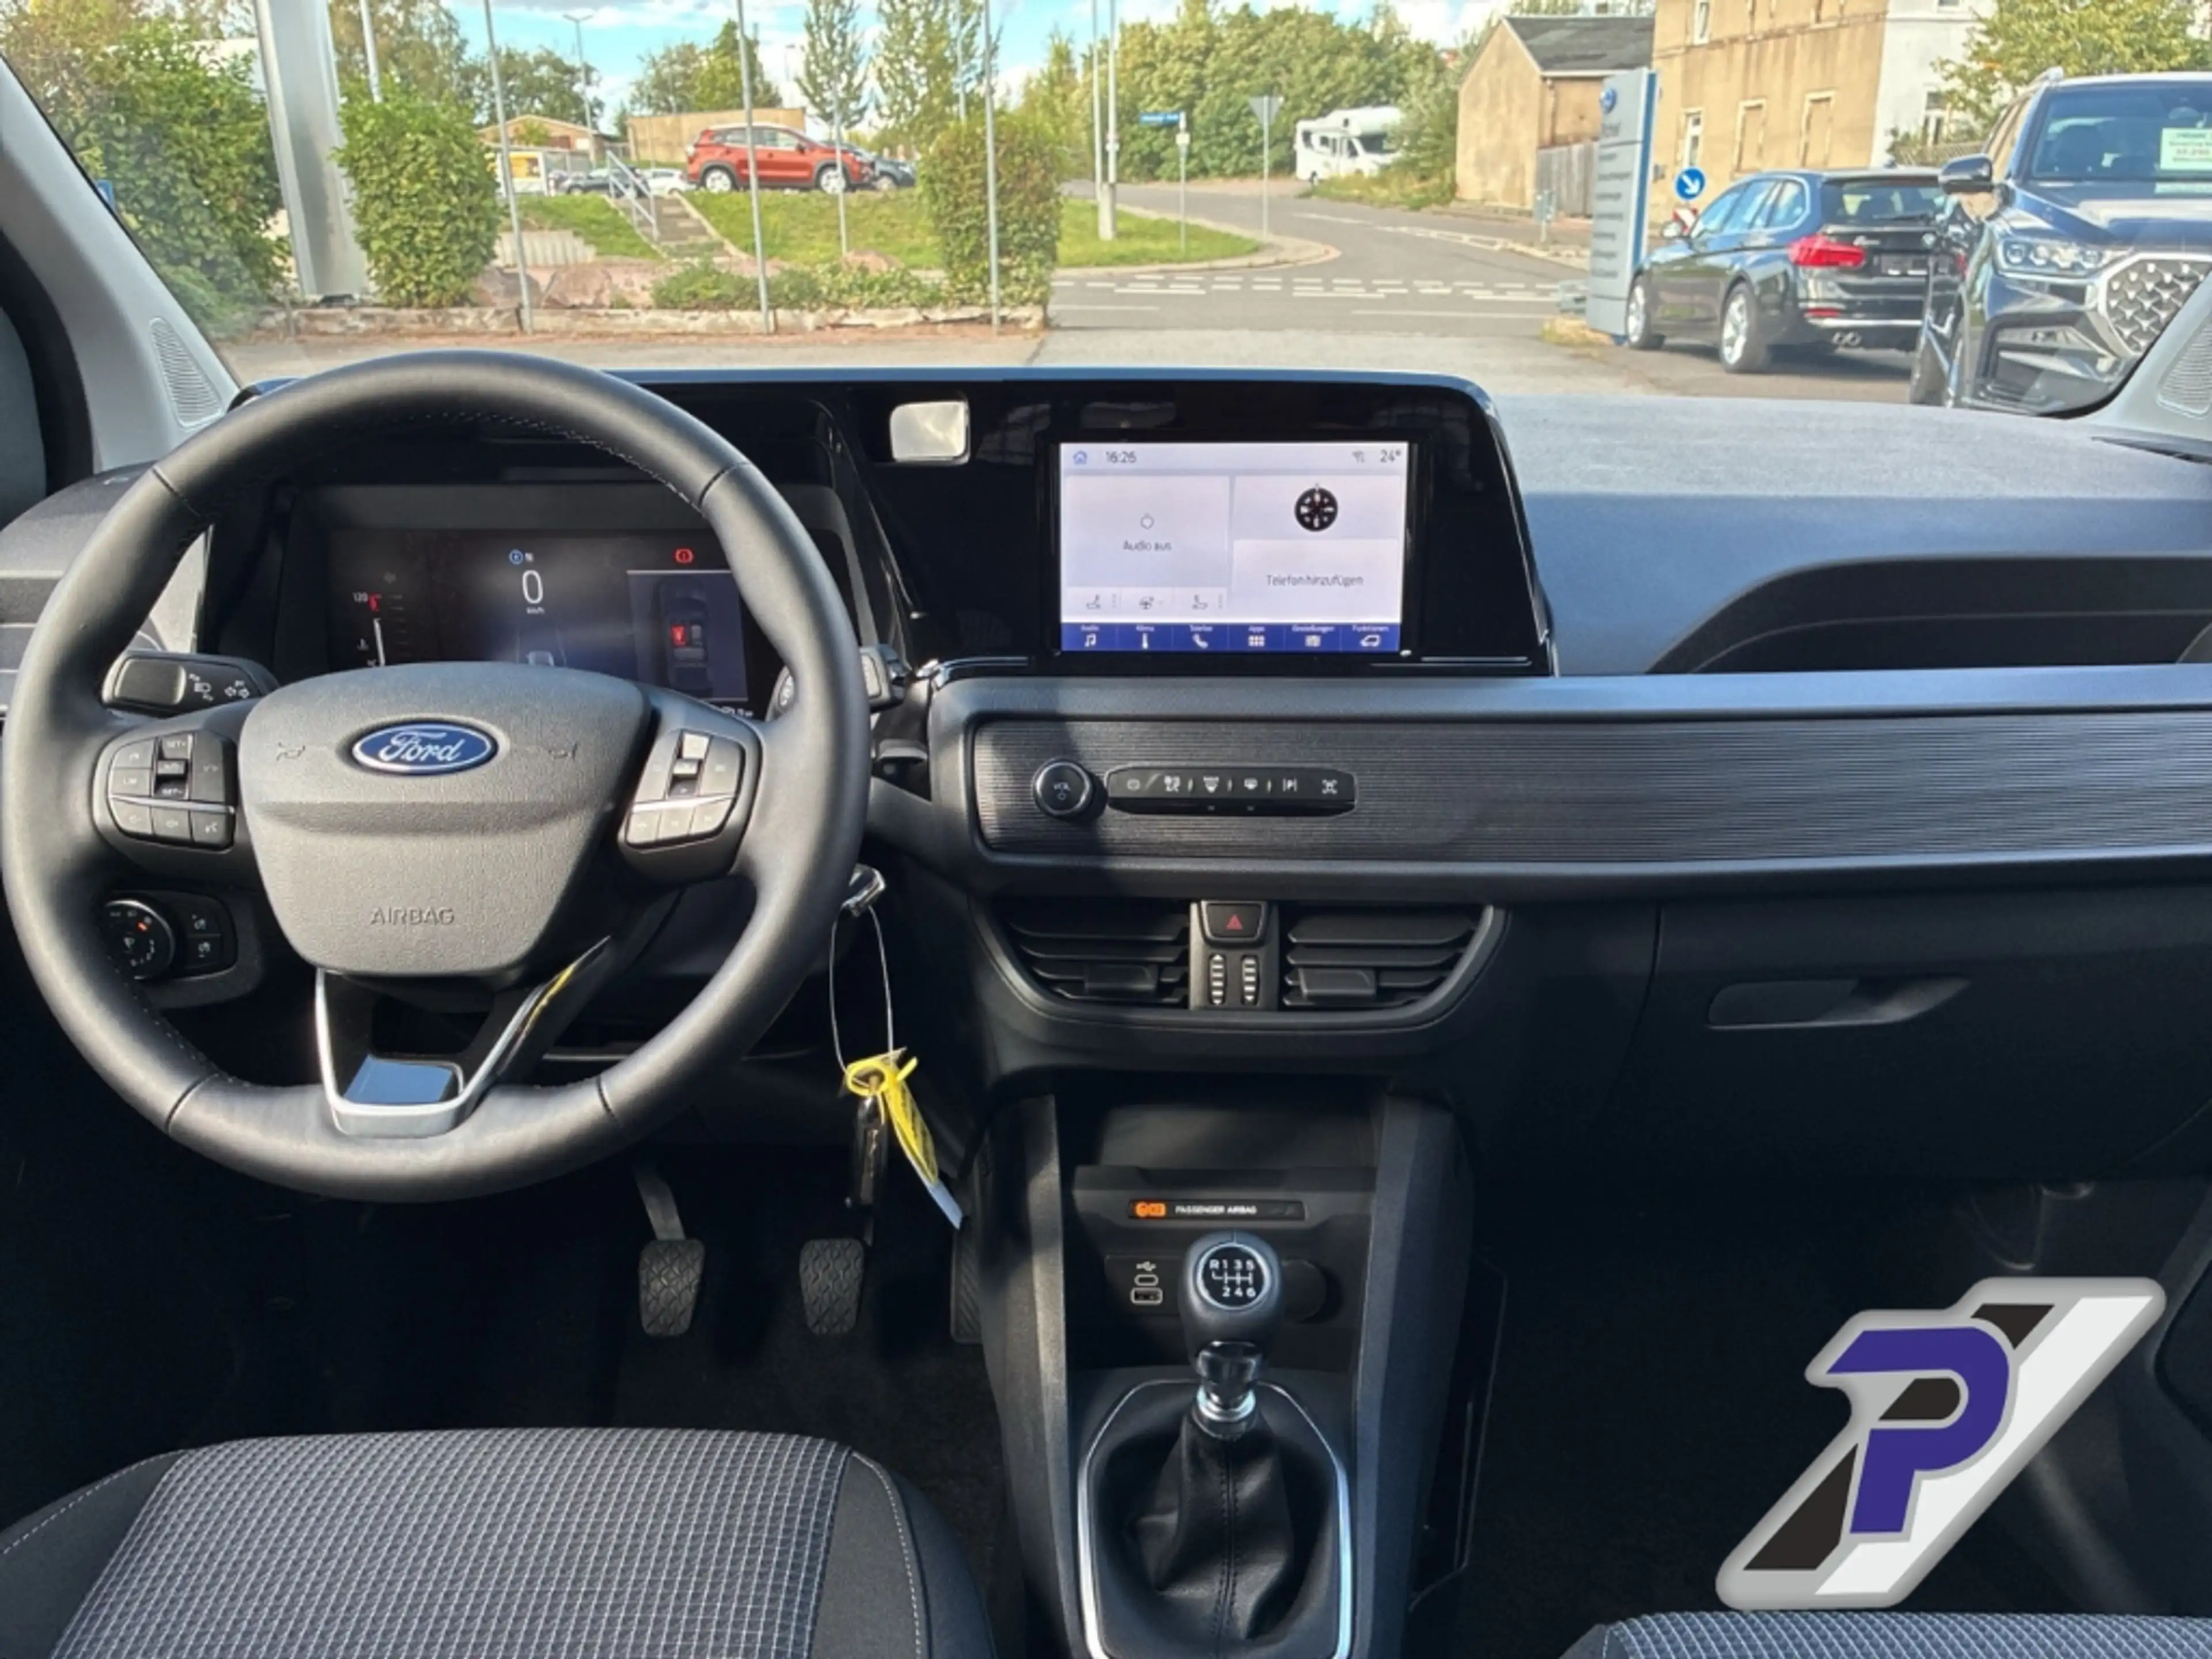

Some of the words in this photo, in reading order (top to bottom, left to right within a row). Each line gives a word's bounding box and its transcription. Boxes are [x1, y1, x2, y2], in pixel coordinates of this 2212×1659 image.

[1106, 451, 1137, 464] 16:26
[1123, 540, 1152, 551] Audio
[1154, 542, 1172, 551] aus
[522, 570, 543, 604] 0
[1266, 575, 1304, 586] Telefon
[1305, 574, 1363, 588] hinzufügen
[378, 732, 465, 762] Ford
[370, 907, 454, 926] AIRBAG
[1175, 1205, 1225, 1215] PASSENGER
[1227, 1205, 1257, 1215] AIRBAG
[1210, 1259, 1219, 1269] R
[1222, 1259, 1228, 1269] 1
[1234, 1259, 1243, 1270] 3
[1246, 1259, 1253, 1271] 5
[1222, 1286, 1230, 1297] 2
[1234, 1287, 1243, 1297] 4
[1246, 1287, 1256, 1297] 6
